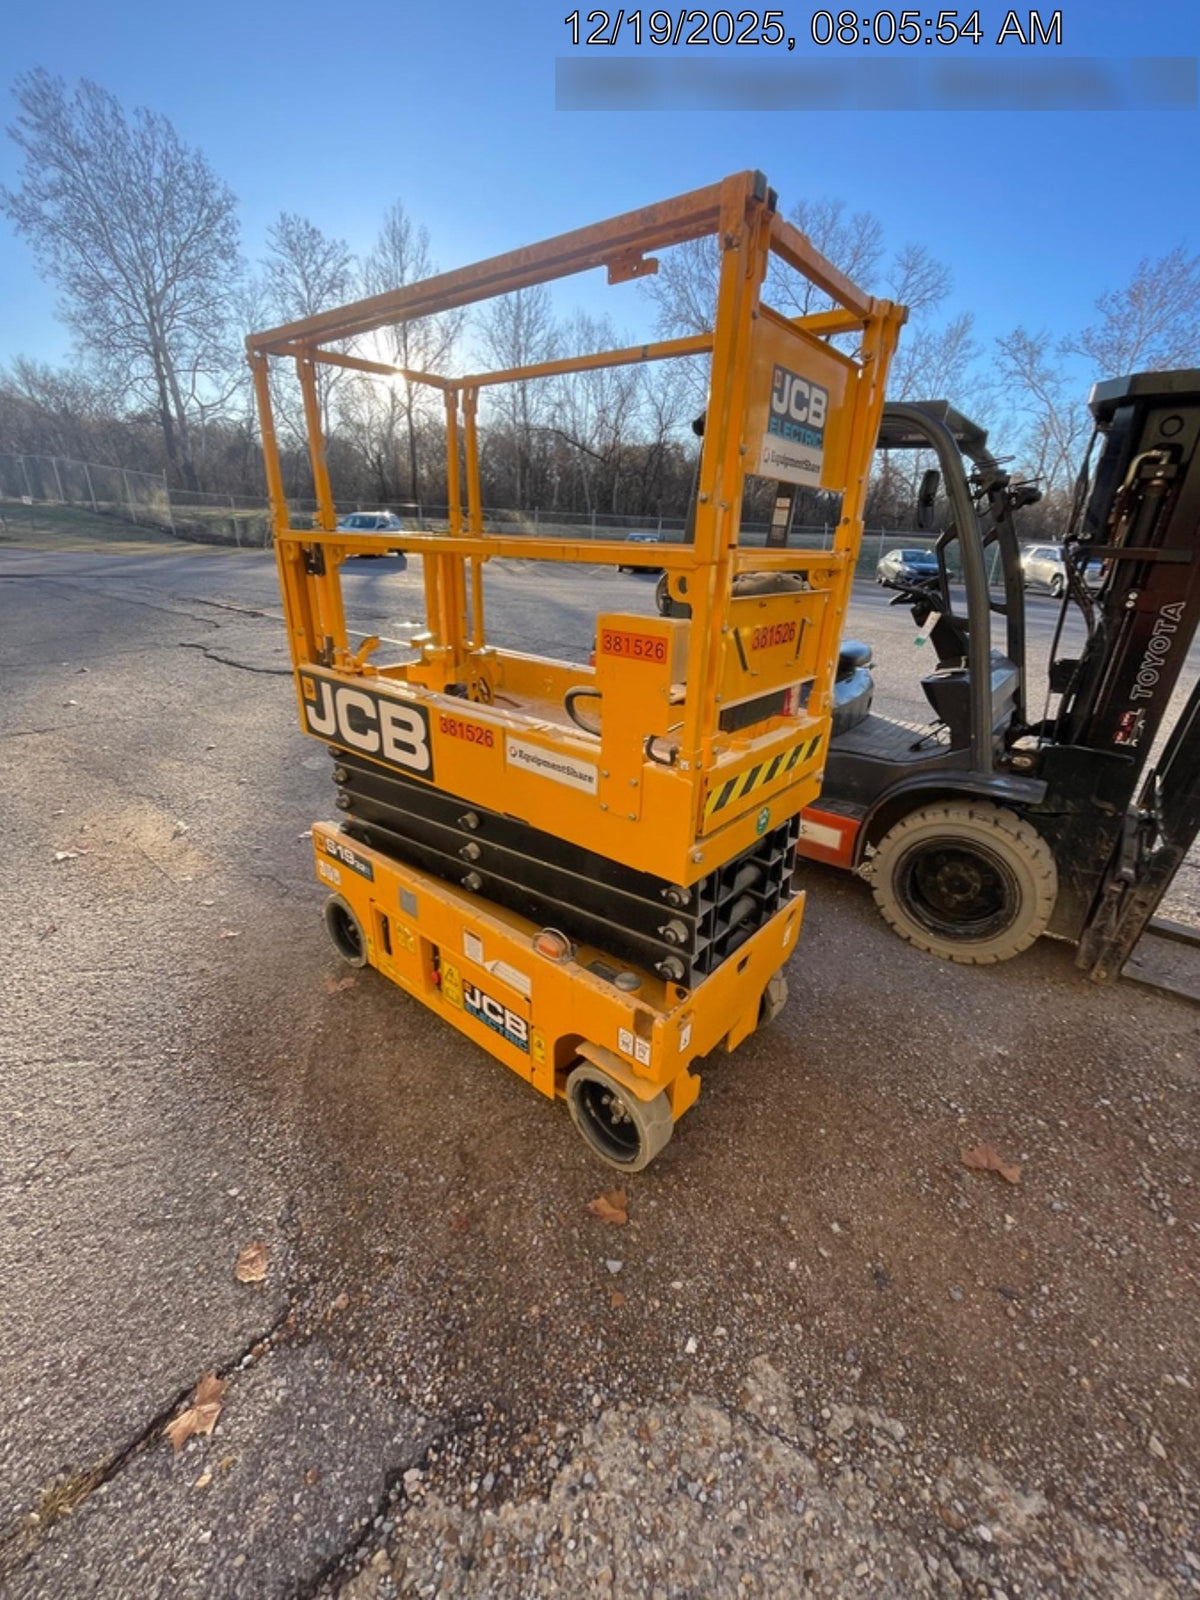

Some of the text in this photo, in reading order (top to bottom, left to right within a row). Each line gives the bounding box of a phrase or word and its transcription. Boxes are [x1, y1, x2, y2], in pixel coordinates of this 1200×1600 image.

[772, 373, 828, 428] JCB
[769, 416, 823, 449] ELECTRIC
[604, 633, 665, 660] 381526
[752, 621, 797, 651] 381526
[1129, 601, 1186, 701] TOYOTA
[306, 681, 430, 772] JCB
[439, 715, 494, 748] 381526
[517, 748, 595, 784] EquipmentShare
[464, 985, 528, 1042] JCB
